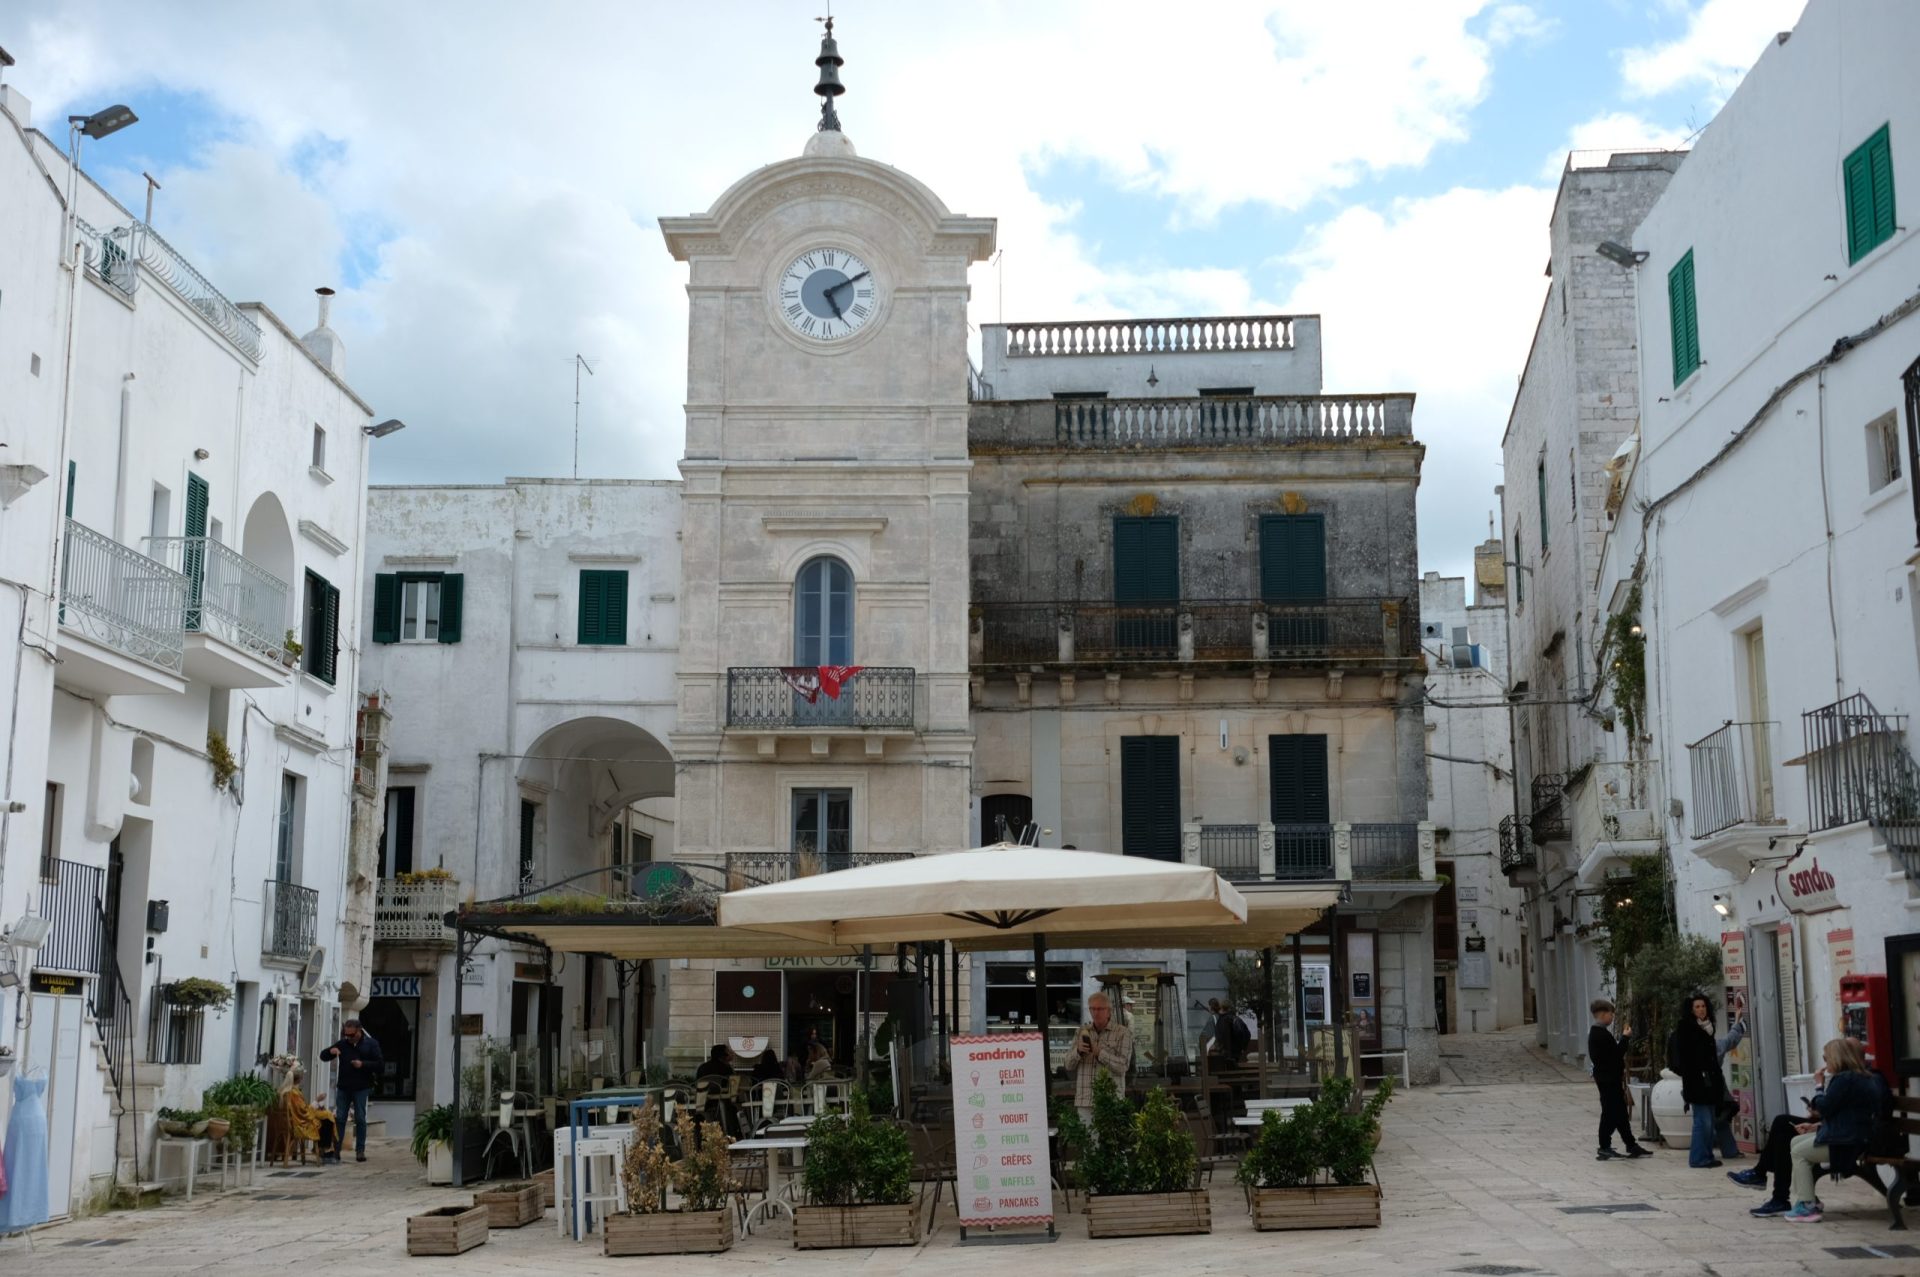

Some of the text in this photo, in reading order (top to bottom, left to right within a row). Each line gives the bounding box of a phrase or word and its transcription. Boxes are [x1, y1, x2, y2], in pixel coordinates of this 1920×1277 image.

[823, 253, 834, 267] XII
[370, 978, 419, 995] STOCK
[969, 1048, 1025, 1061] sandrino
[999, 1069, 1024, 1079] GELATI
[1002, 1093, 1024, 1103] DOLCI
[999, 1113, 1028, 1124] YOGURT
[1001, 1134, 1029, 1144] FRUTTA
[1000, 1176, 1035, 1187] WAFFLES
[999, 1197, 1039, 1208] PANCAKES
